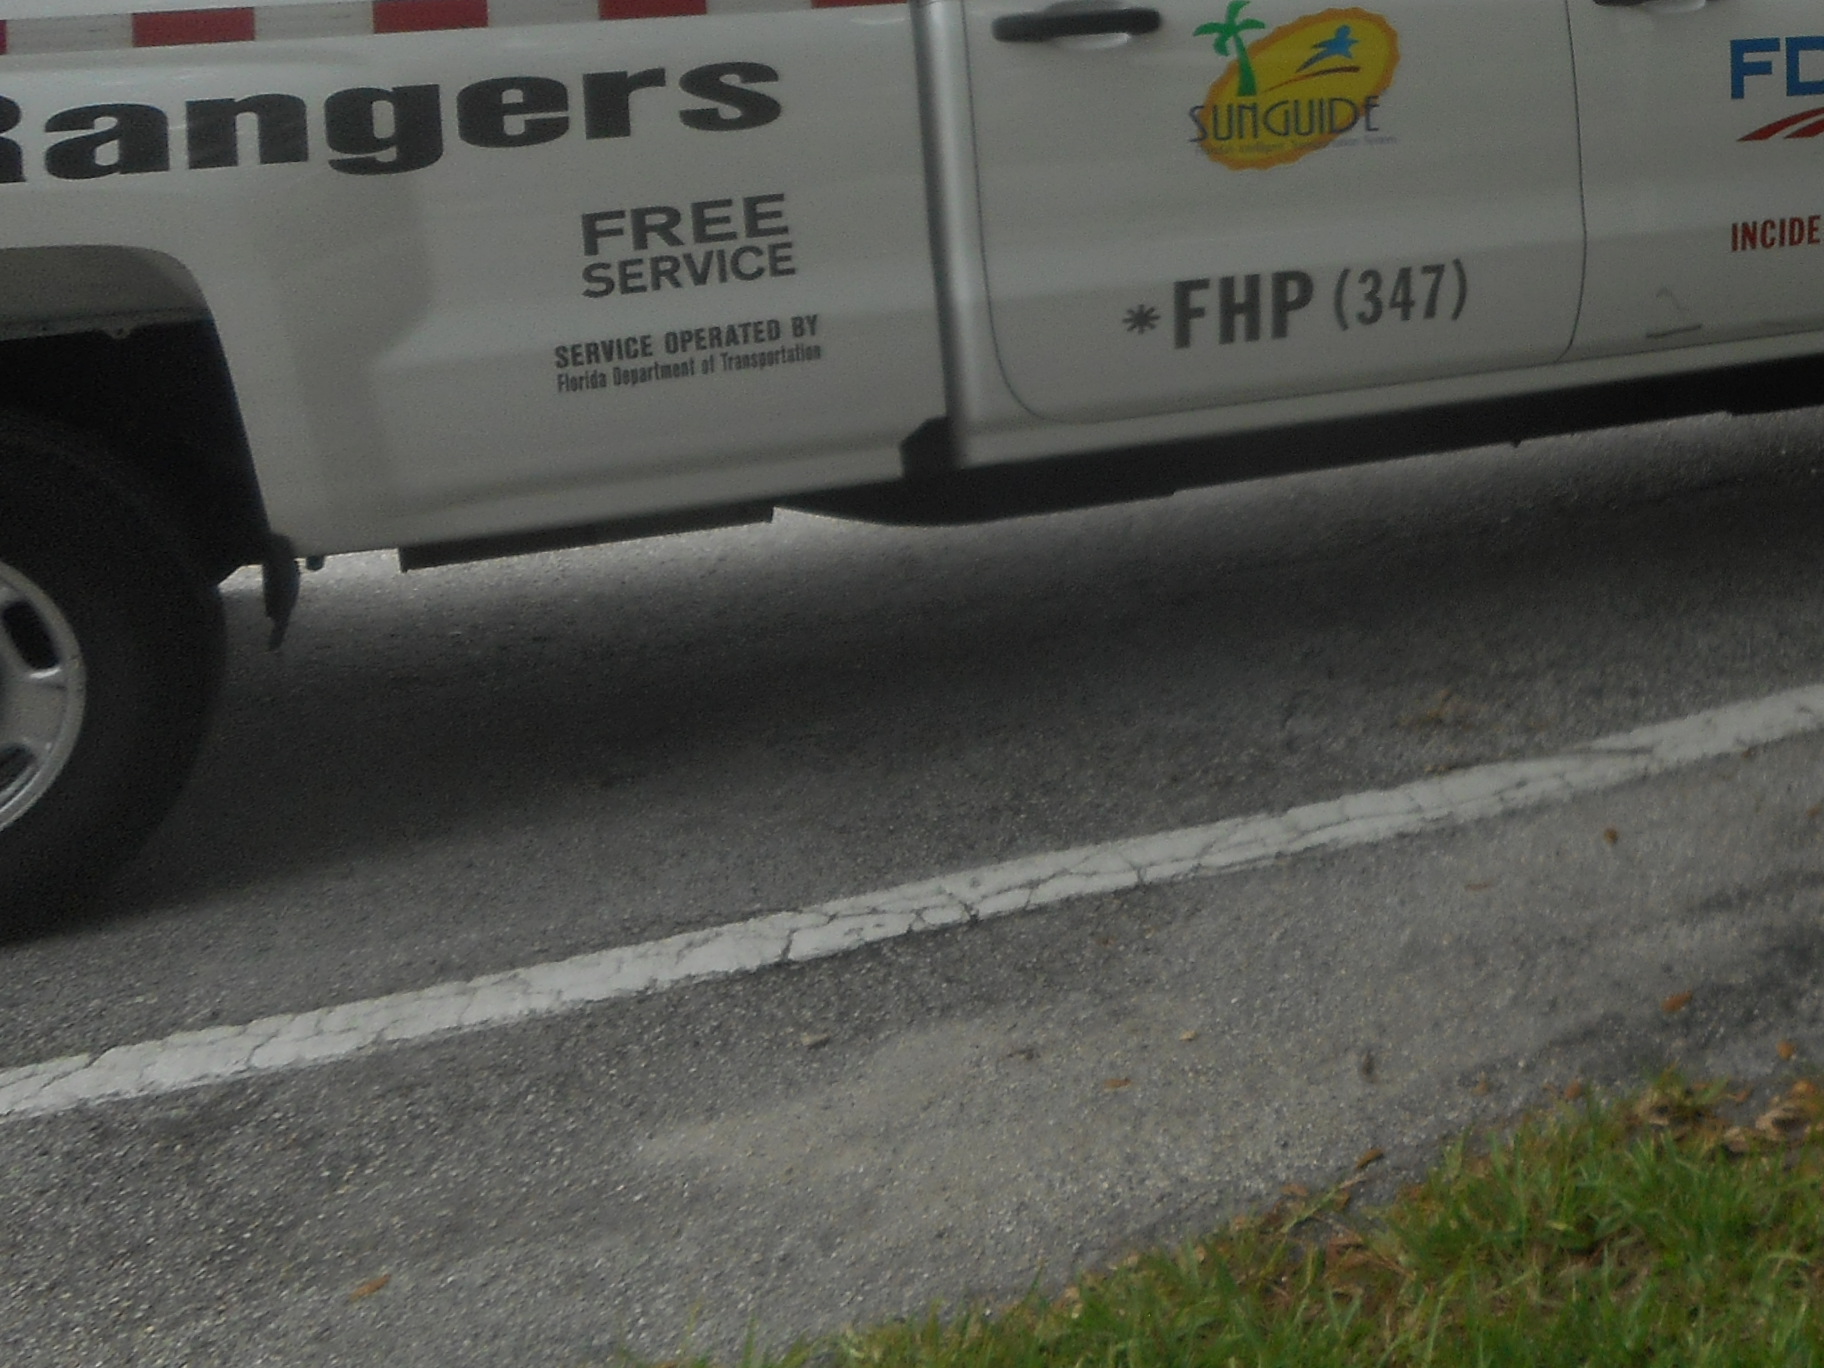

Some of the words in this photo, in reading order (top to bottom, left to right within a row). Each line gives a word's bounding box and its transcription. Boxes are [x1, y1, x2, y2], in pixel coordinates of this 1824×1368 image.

[1189, 95, 1381, 143] SUNGUIDE
[581, 193, 790, 256] FREE
[581, 242, 796, 298] SERVICE
[1333, 259, 1468, 331] (347)
[555, 334, 653, 368] SERVICE
[664, 319, 780, 354] OPERATED
[791, 314, 818, 338] BY
[557, 370, 607, 393] Florida
[613, 360, 695, 387] Department
[702, 354, 715, 375] of
[720, 343, 821, 371] Transportation
